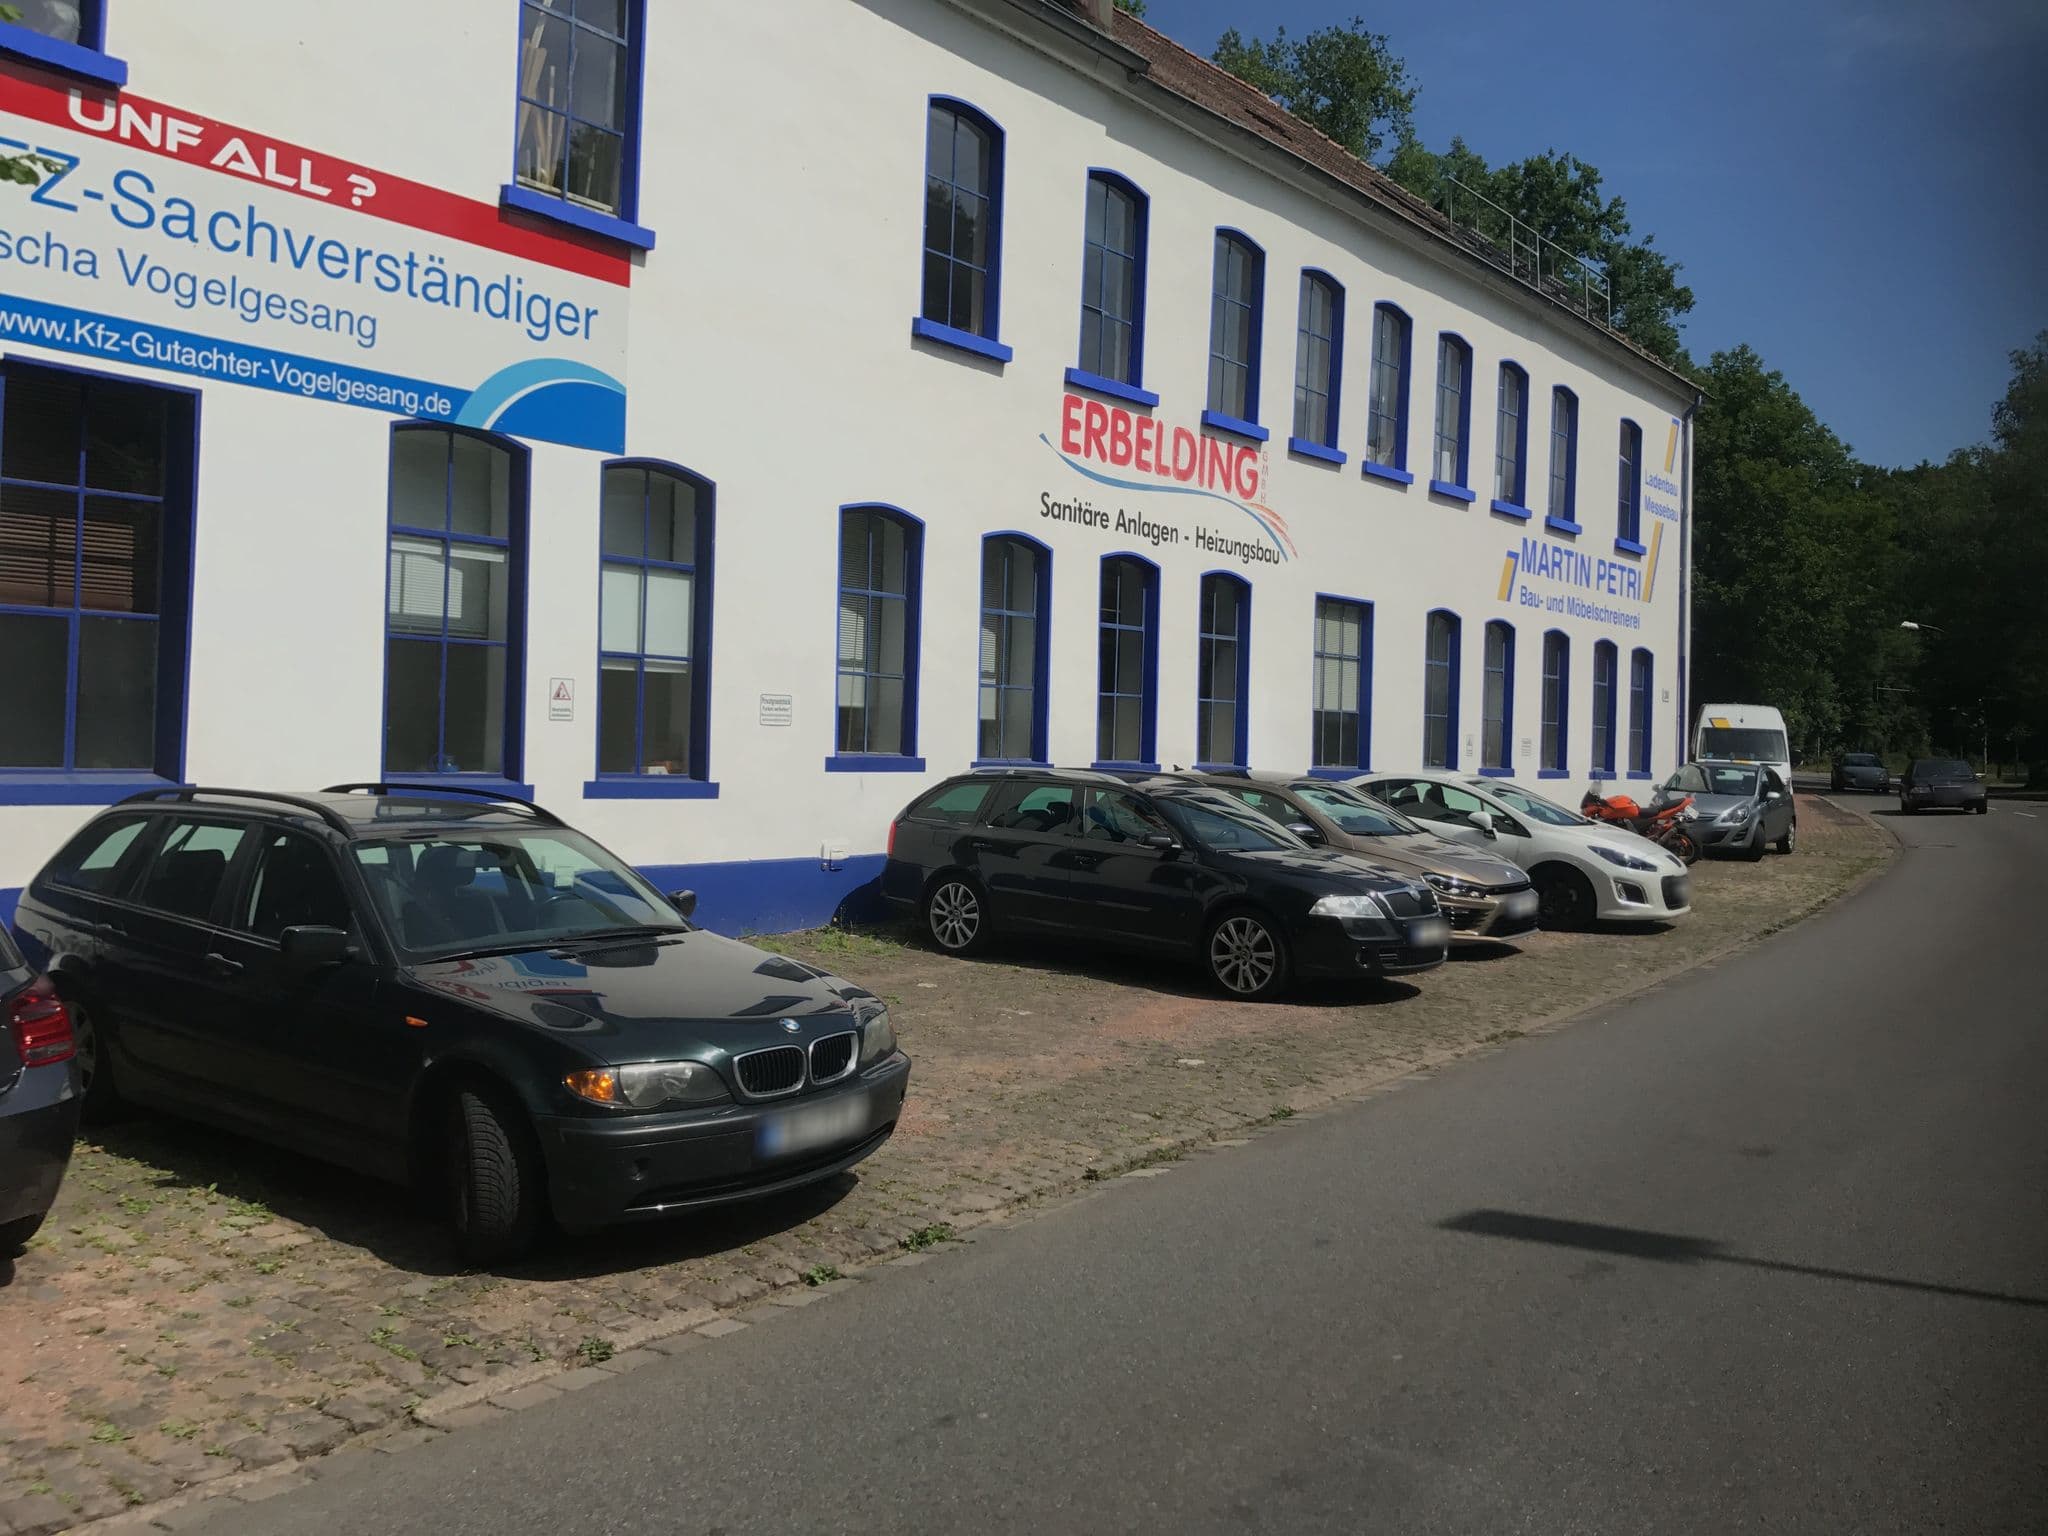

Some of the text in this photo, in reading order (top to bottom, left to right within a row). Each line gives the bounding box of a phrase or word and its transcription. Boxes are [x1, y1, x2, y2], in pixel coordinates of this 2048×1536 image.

[346, 173, 377, 207] ?
[0, 136, 599, 343] Z-Sachverständiger
[0, 229, 378, 349] scha Vogelgesang
[1060, 393, 1259, 501] ERBELDING
[1644, 467, 1678, 497] Ladenbau
[1644, 495, 1679, 522] Messebau
[1040, 491, 1110, 530] Sanitäre
[1114, 508, 1179, 547] Anlagen
[1195, 525, 1280, 565] Heizungsbau
[1520, 536, 1641, 601] MARTIN PETRI
[1520, 584, 1641, 630] Bau- und Möbelschreinerei
